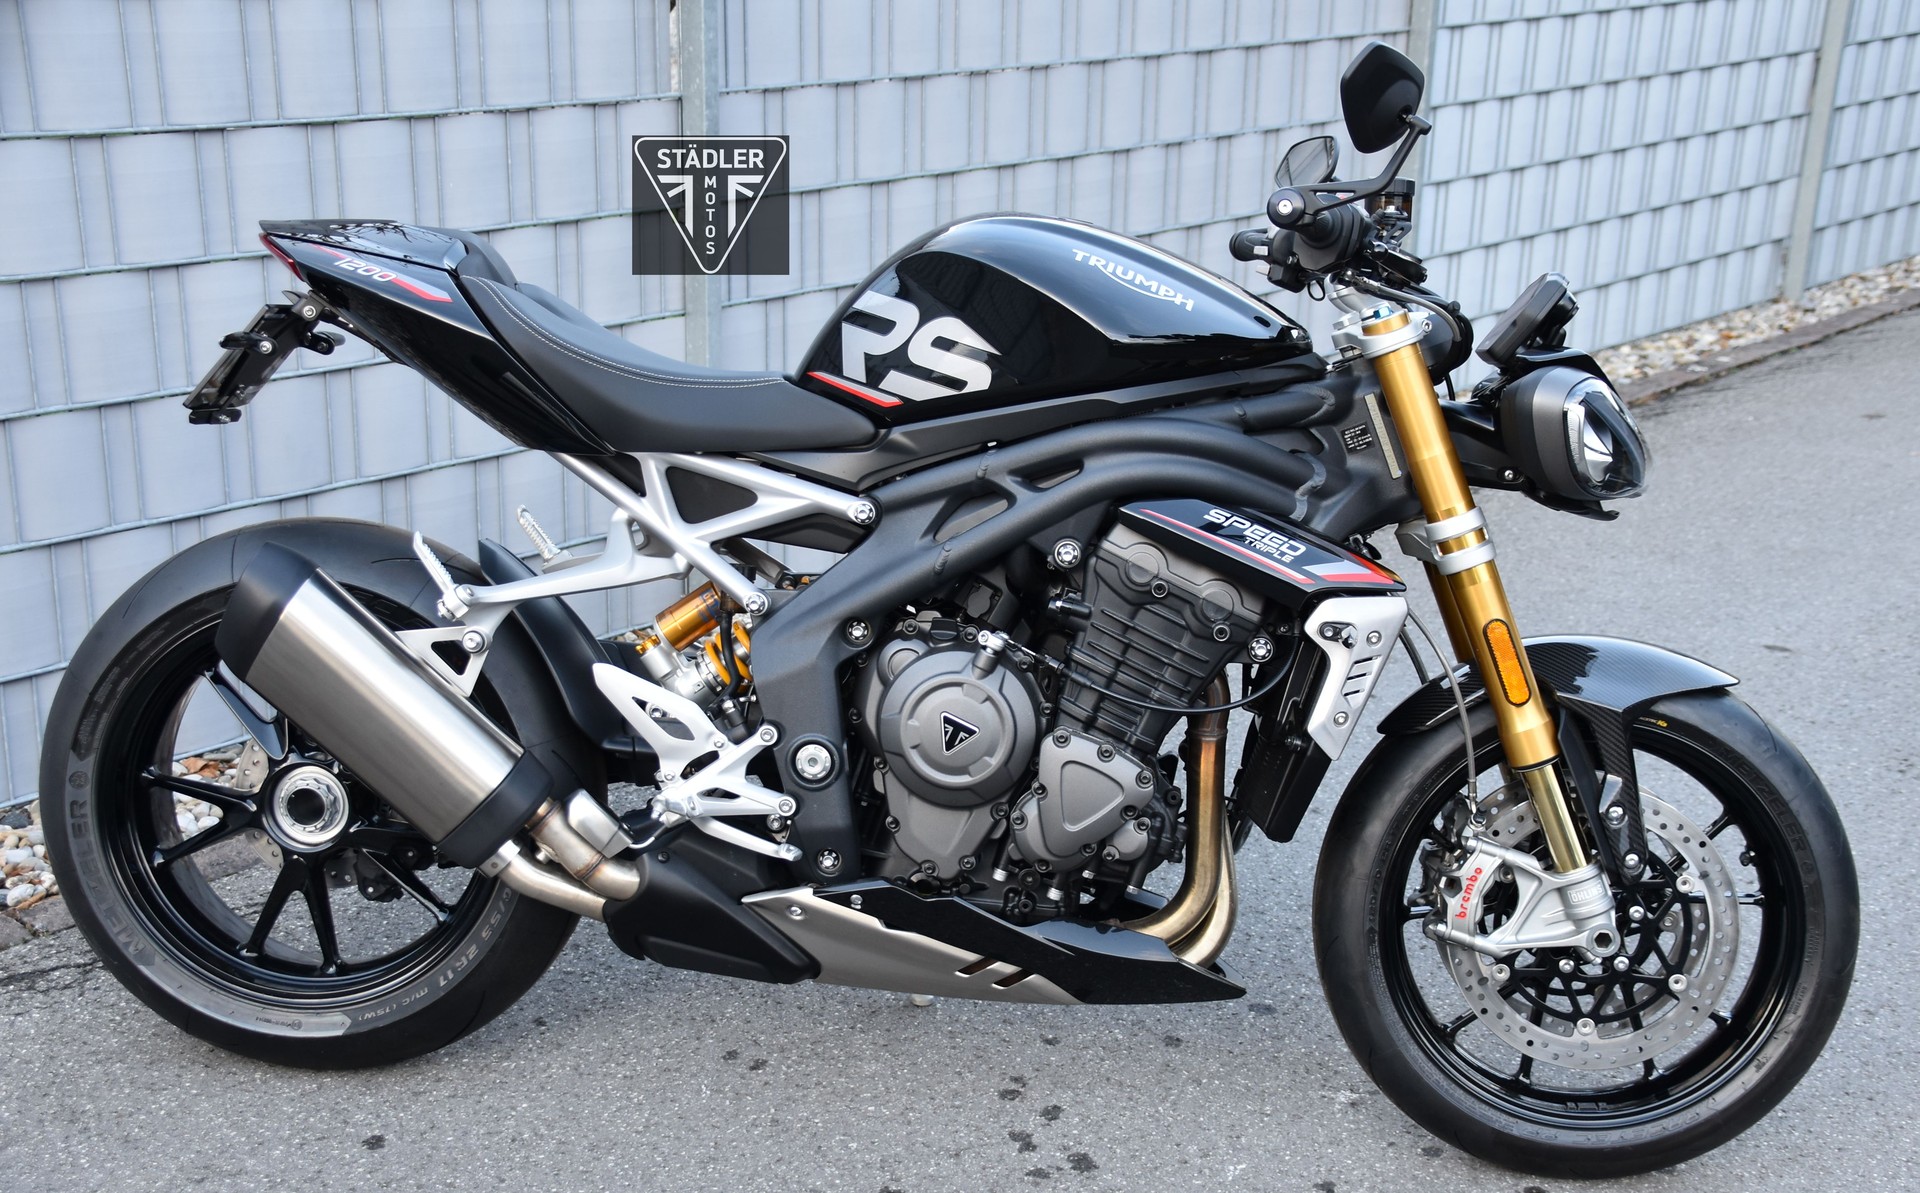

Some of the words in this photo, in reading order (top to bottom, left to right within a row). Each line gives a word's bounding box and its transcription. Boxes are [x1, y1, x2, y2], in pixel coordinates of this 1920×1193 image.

[333, 257, 397, 281] 1200
[1072, 248, 1195, 312] TRIUMPH
[1203, 508, 1306, 557] SPEED
[1244, 536, 1295, 563] TRIPLE
[1716, 745, 1809, 852] METZELER
[69, 799, 147, 959] METZELER
[1455, 867, 1483, 919] brembo
